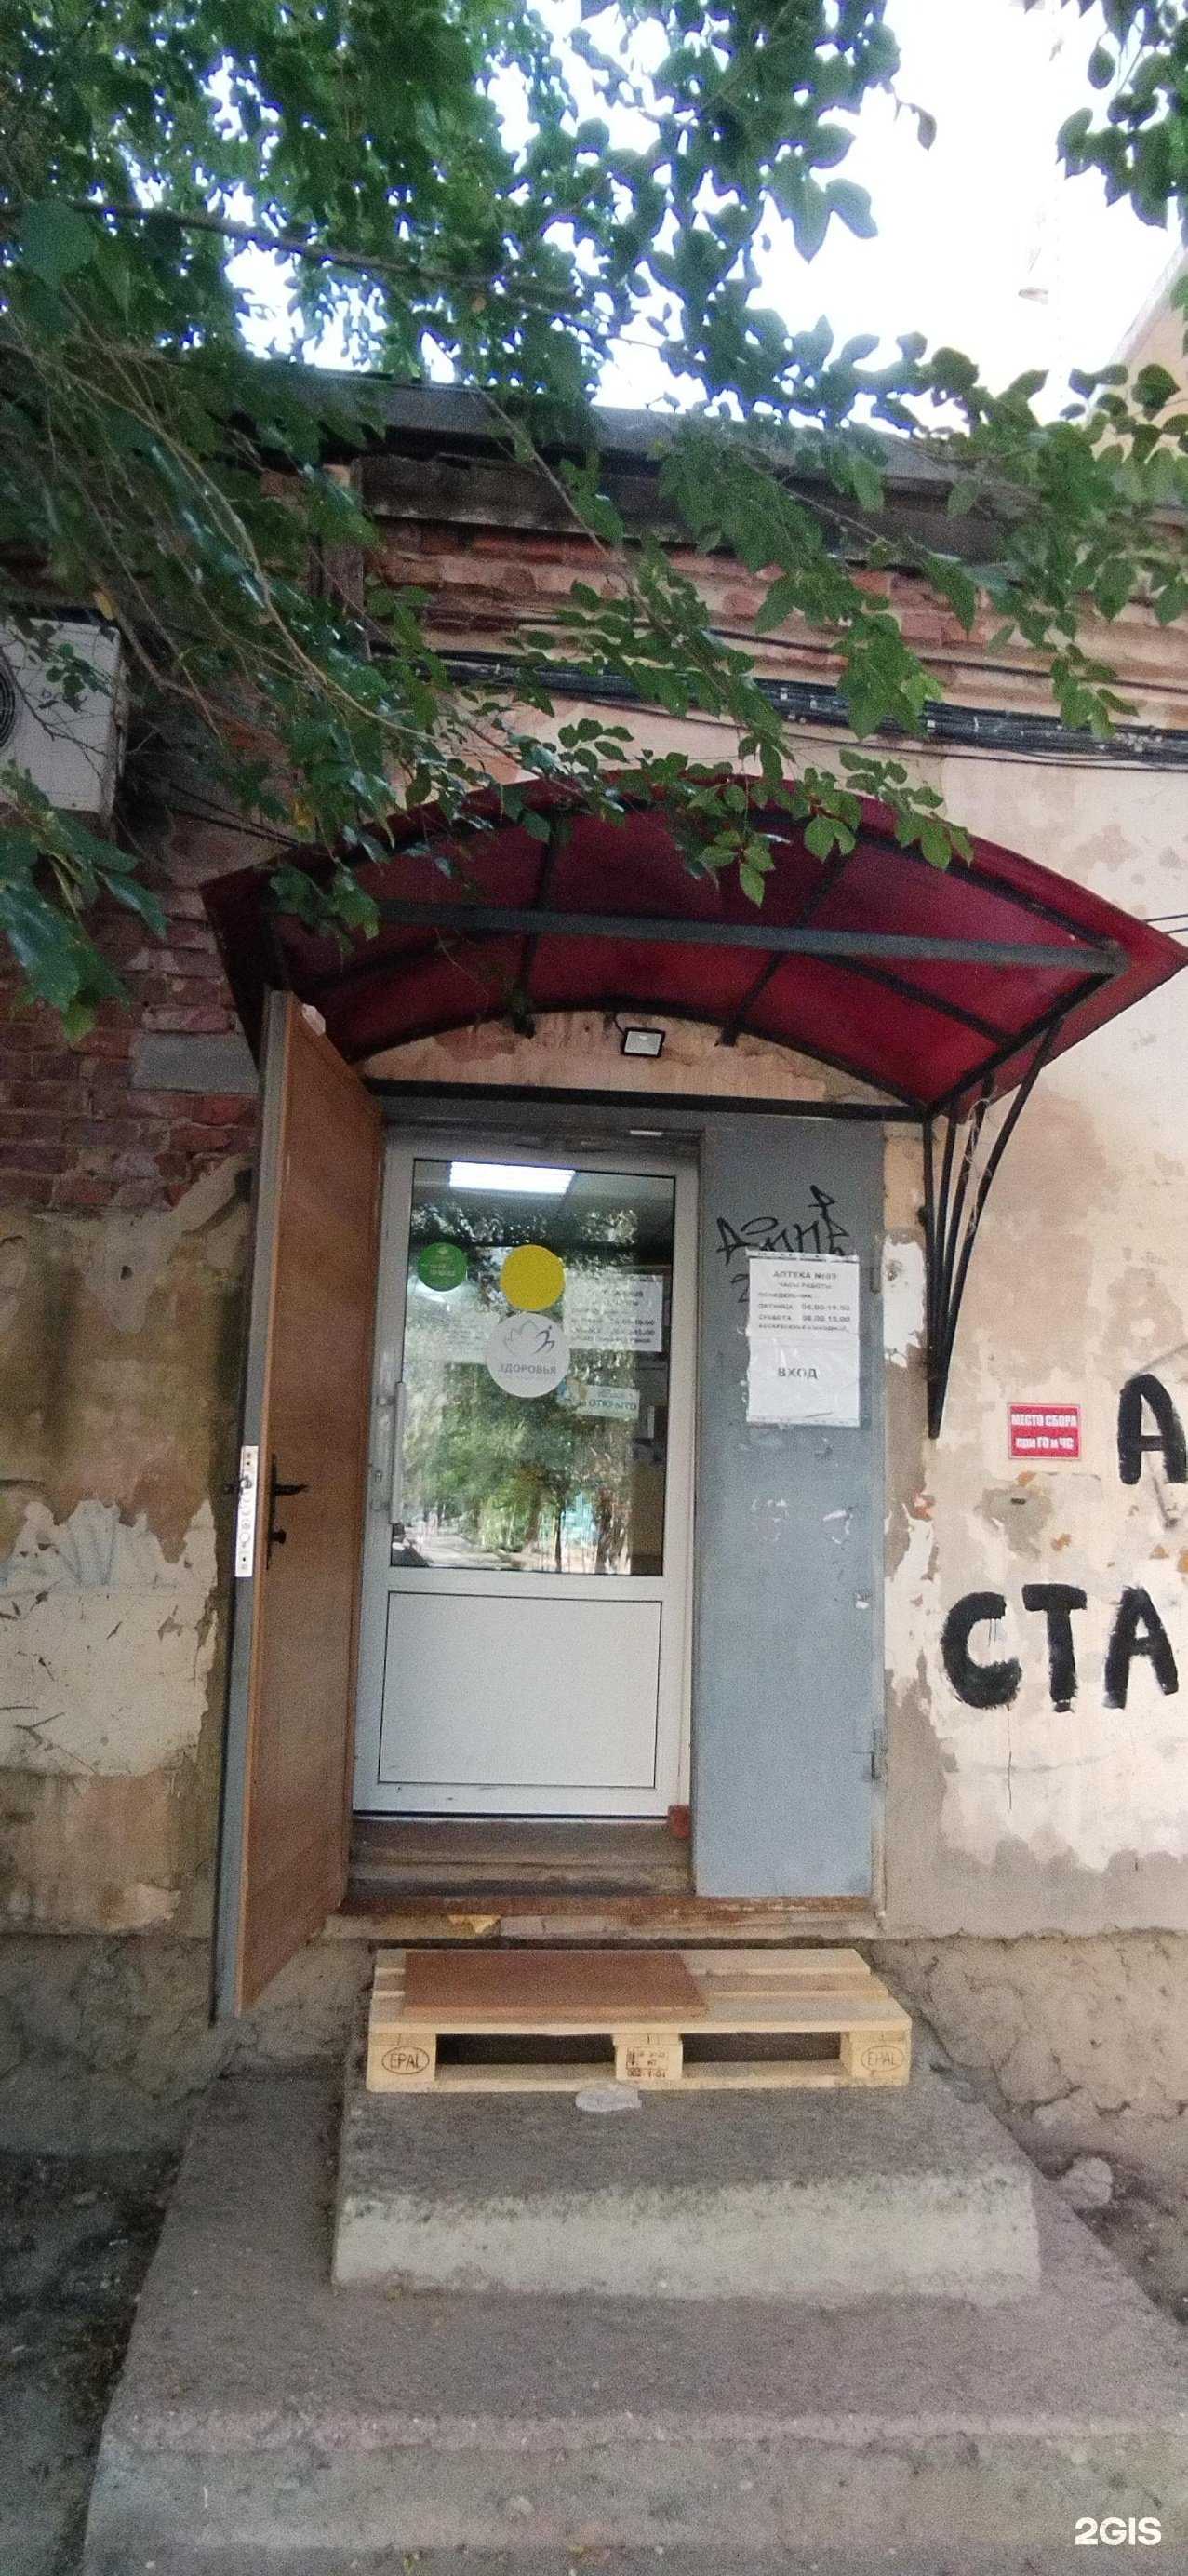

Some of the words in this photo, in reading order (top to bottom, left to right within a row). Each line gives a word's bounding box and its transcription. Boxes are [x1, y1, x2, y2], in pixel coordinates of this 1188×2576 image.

[773, 1270, 811, 1280] АПТЕКА
[778, 1367, 819, 1380] ВХОД
[1011, 1414, 1044, 1427] МЕСТО
[1045, 1415, 1077, 1428] СБОРА
[1036, 1436, 1049, 1449] ГО
[1059, 1437, 1074, 1450] ЧС
[941, 1583, 1180, 1714] СТА
[390, 2052, 423, 2070] EPAL
[867, 2051, 901, 2067] EPAL
